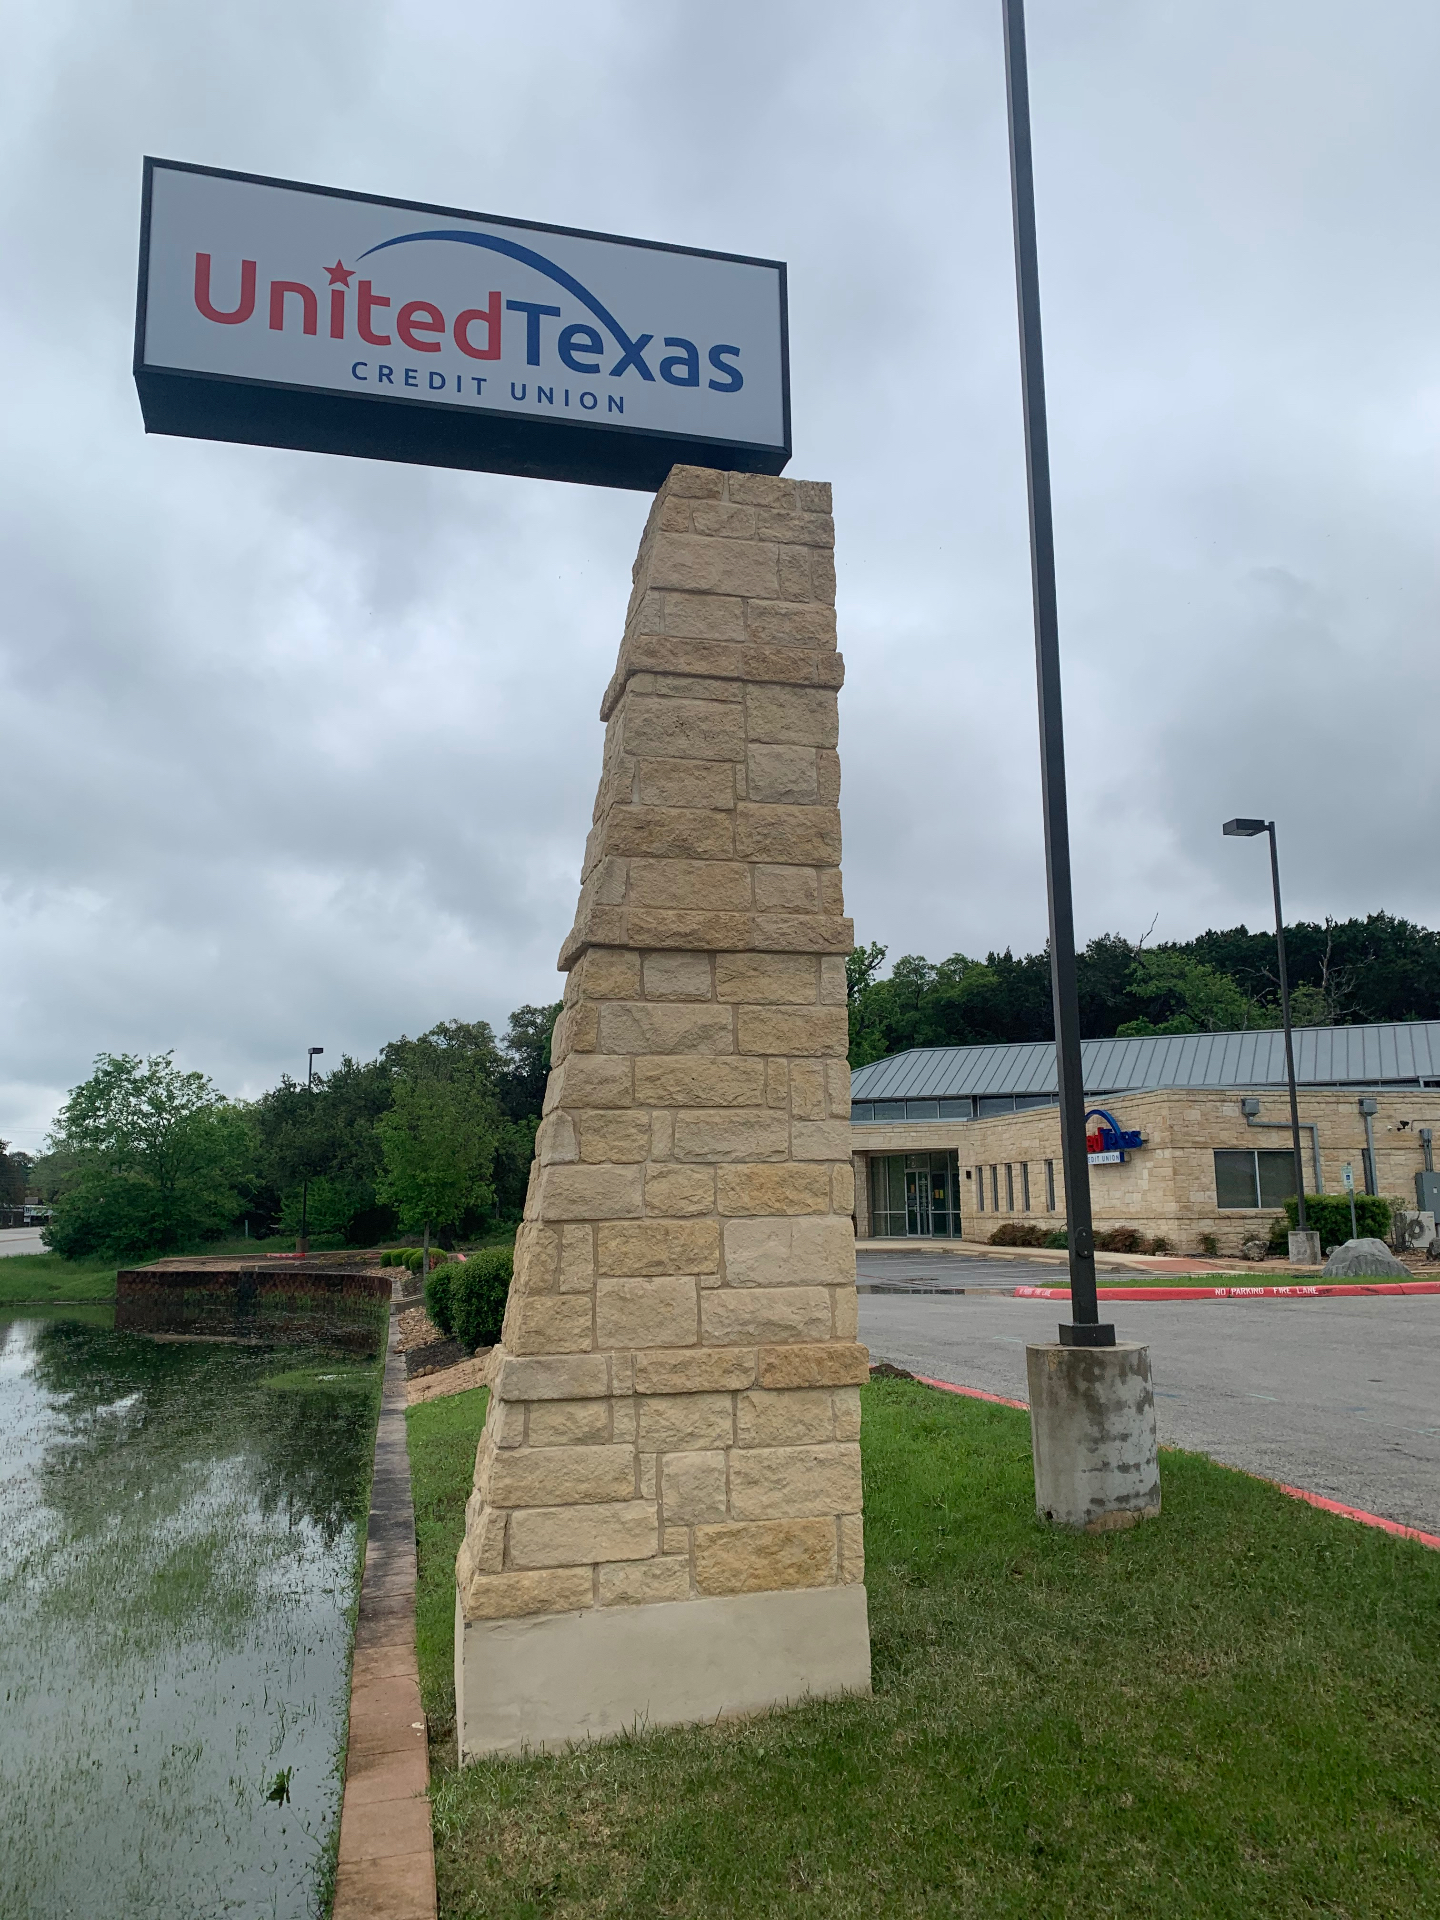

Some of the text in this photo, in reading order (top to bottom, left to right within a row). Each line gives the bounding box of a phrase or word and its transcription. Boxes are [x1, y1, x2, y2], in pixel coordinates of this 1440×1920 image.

[351, 361, 624, 414] CREDIT UNION
[1088, 1154, 1120, 1163] EDIT UNION
[1215, 1286, 1319, 1296] NO PARKING FIRE LANE
